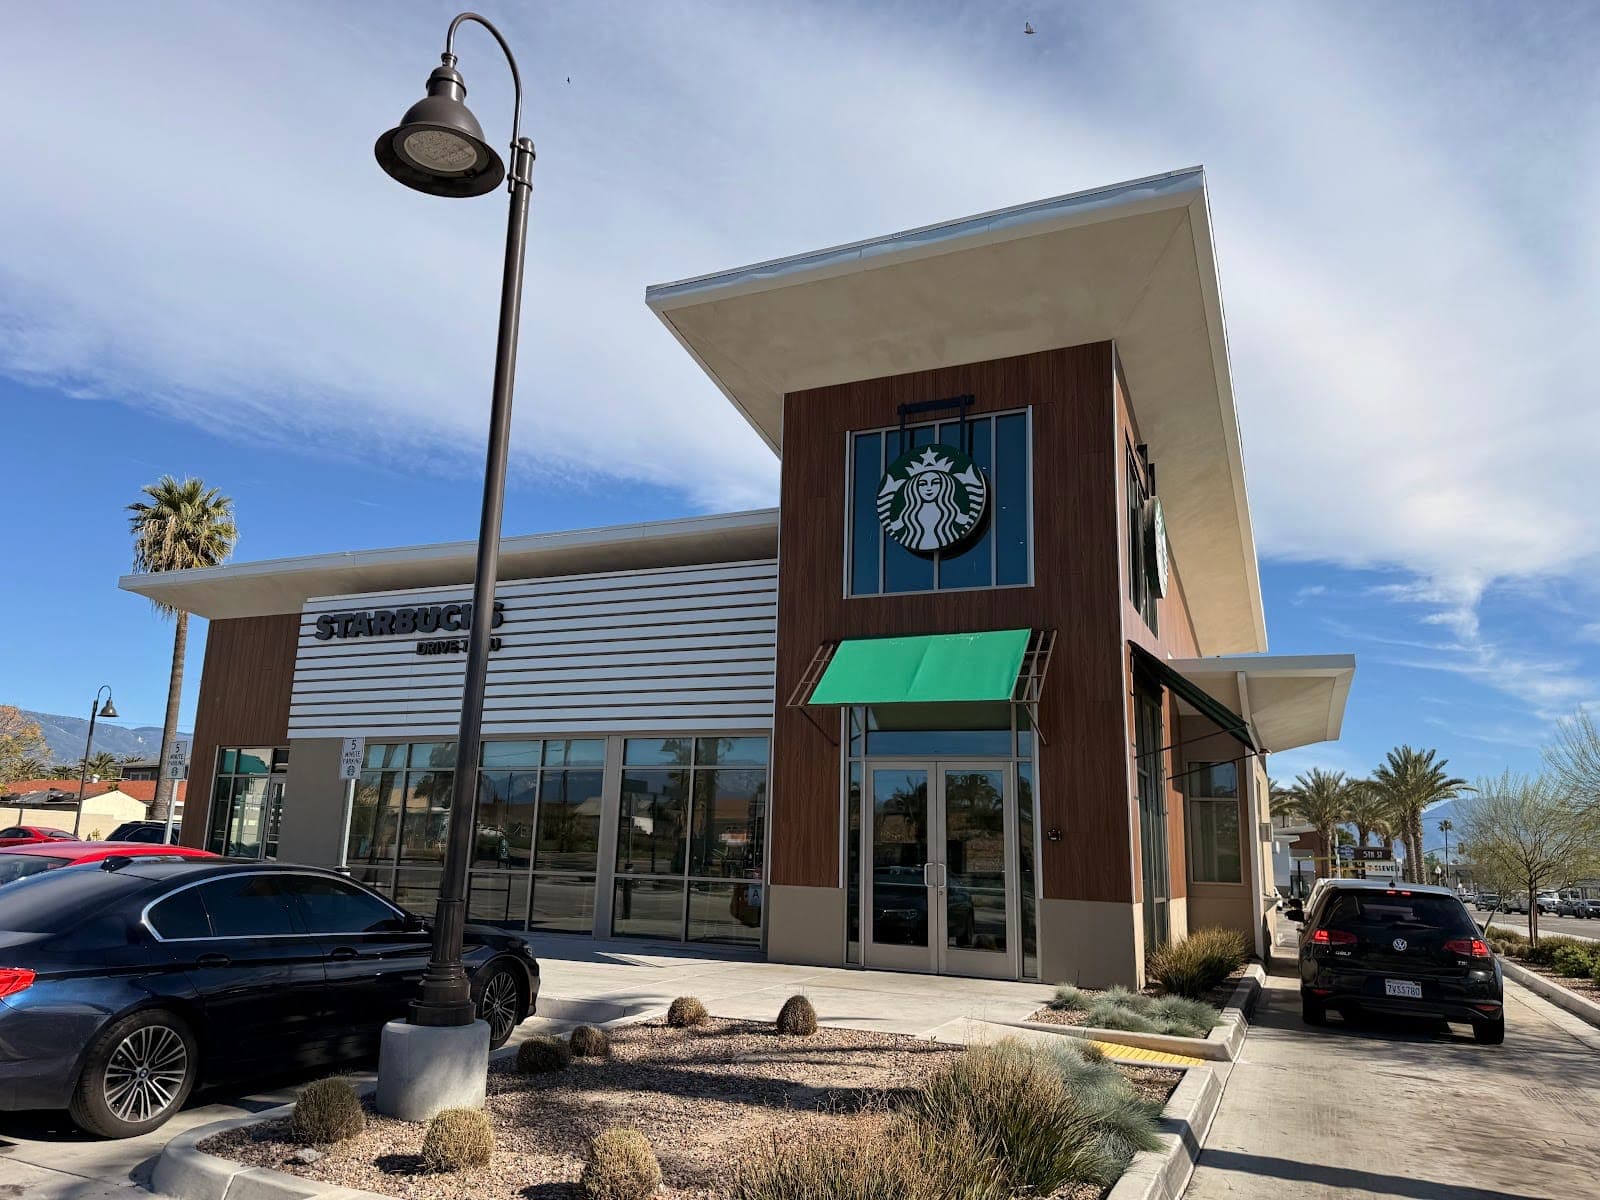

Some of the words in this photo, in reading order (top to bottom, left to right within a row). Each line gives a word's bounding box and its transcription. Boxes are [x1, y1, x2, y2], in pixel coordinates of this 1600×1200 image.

[416, 640, 460, 655] DRIVE
[461, 637, 502, 652] TU
[175, 743, 180, 753] 5
[352, 739, 357, 750] 5
